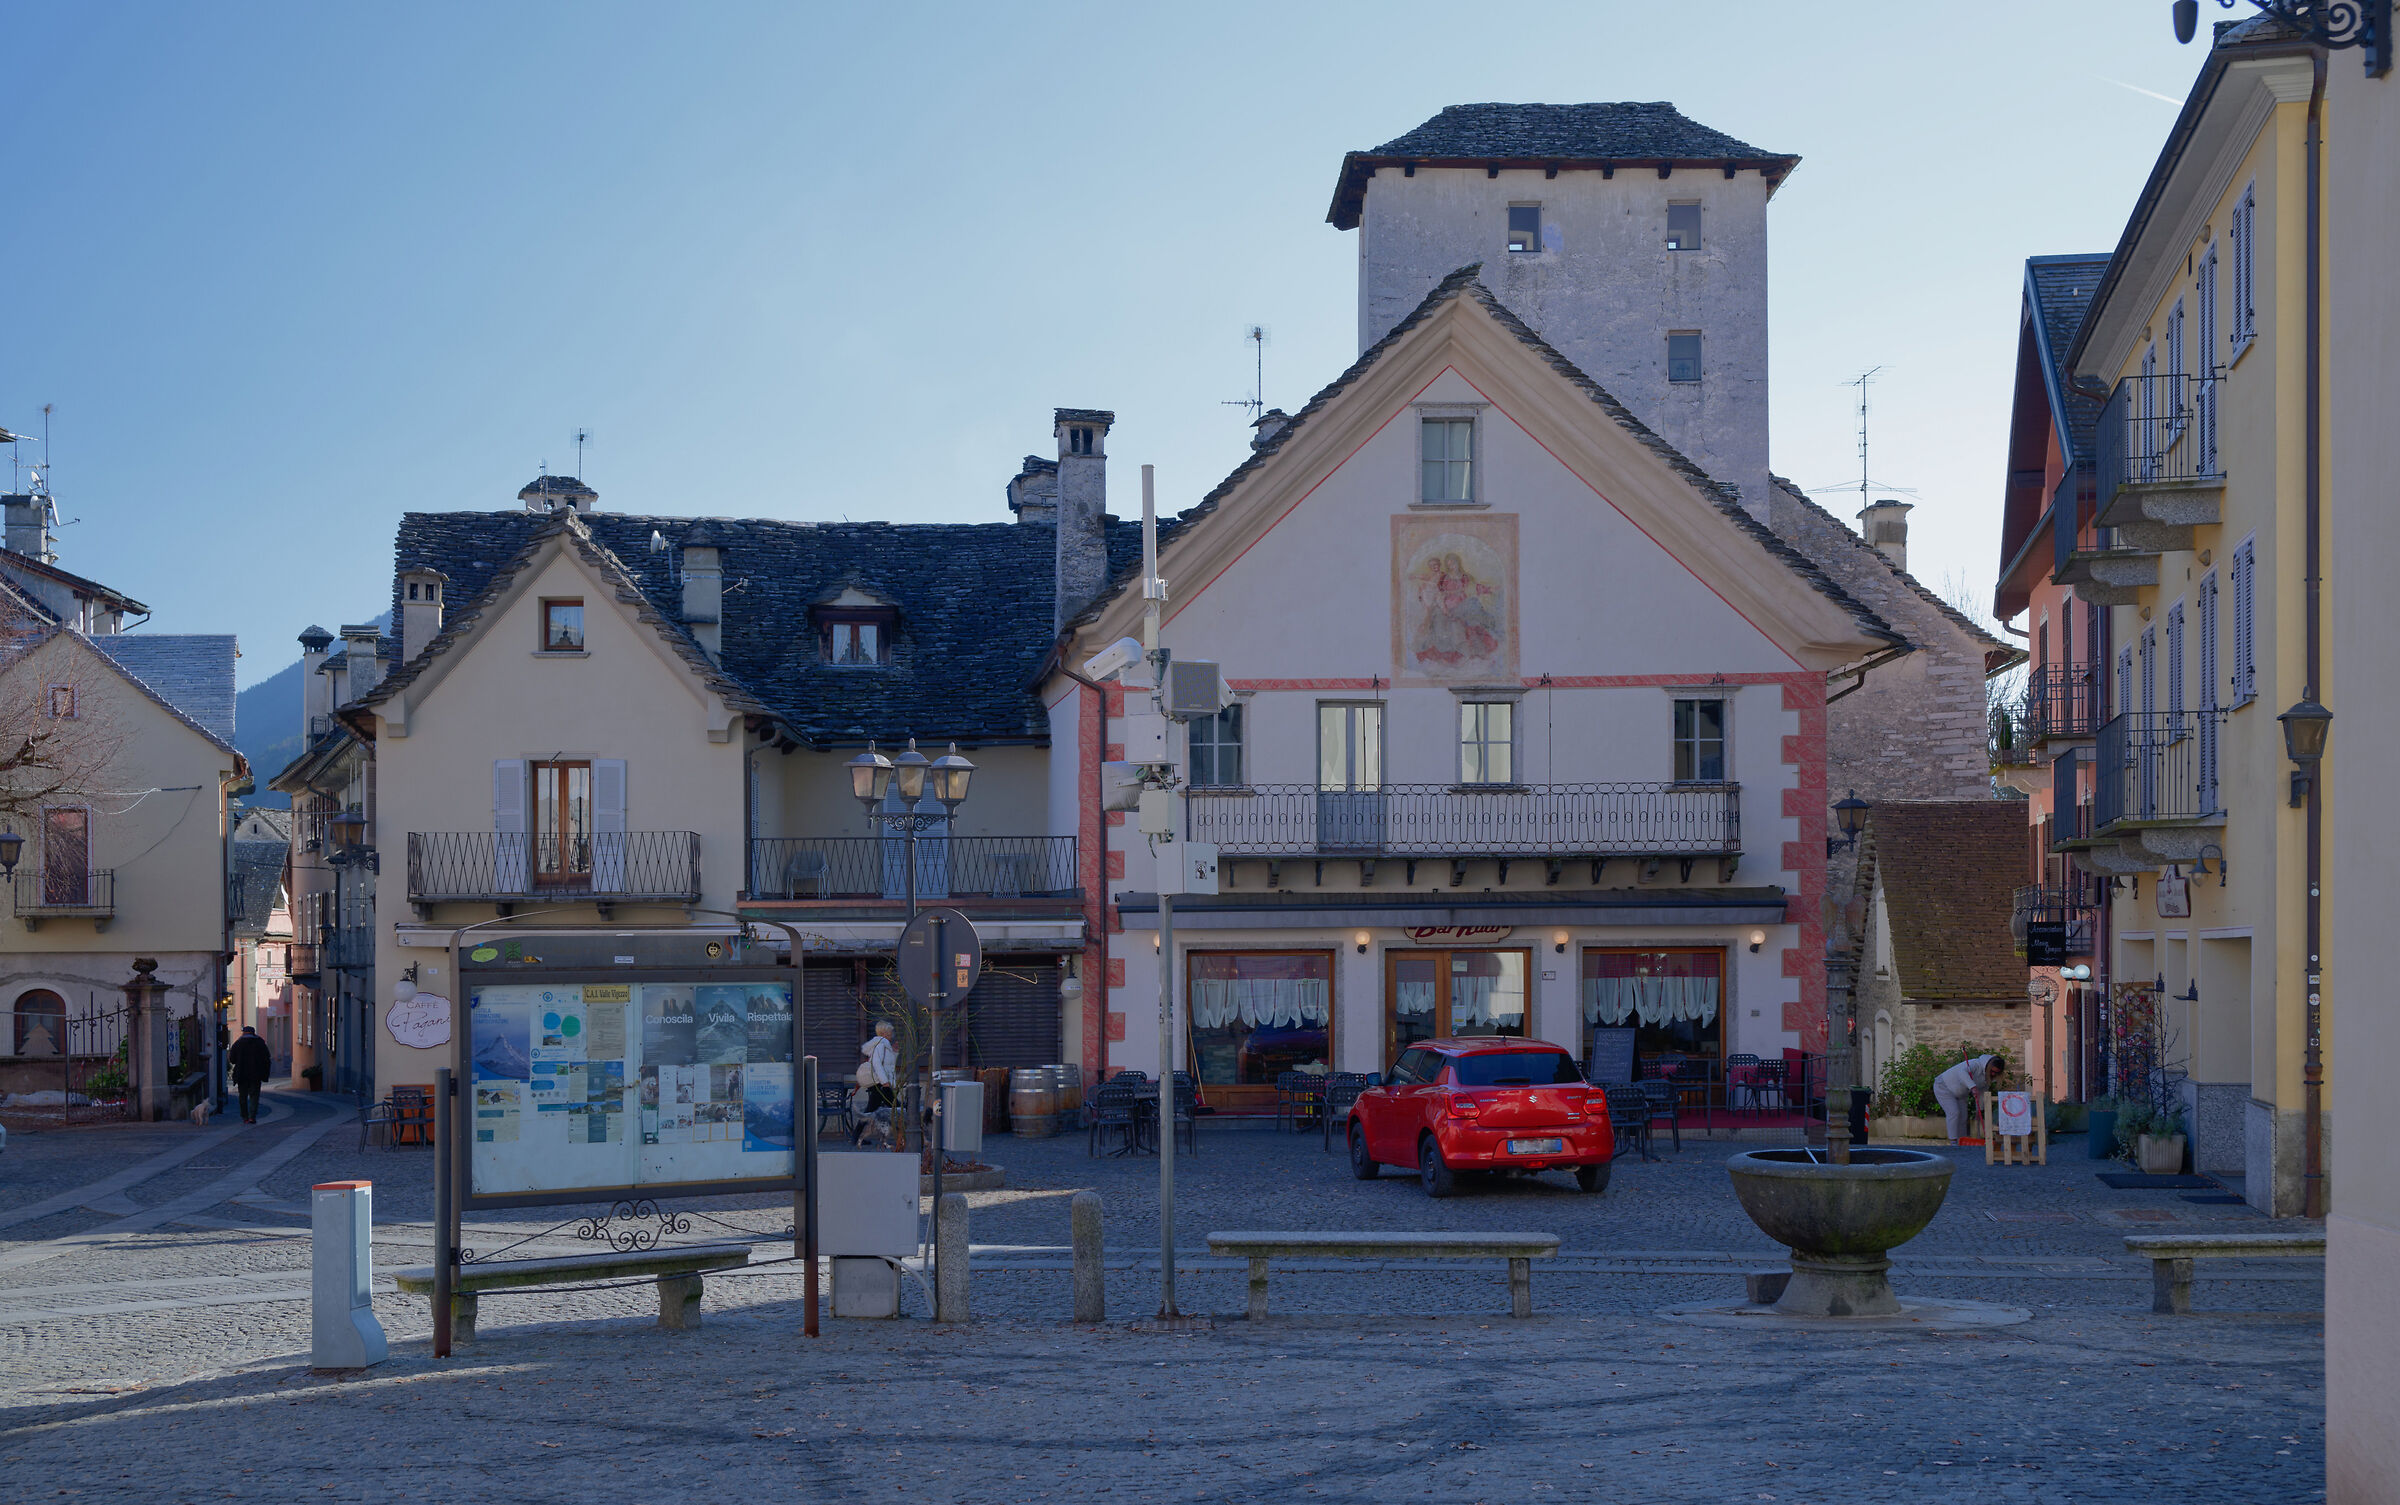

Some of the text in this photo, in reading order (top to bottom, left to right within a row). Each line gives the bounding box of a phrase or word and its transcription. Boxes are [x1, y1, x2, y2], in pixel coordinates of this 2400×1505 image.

[407, 1000, 439, 1009] CAFFÈ
[645, 1013, 693, 1024] Conoscila
[708, 1012, 735, 1023] Vivila
[391, 1012, 450, 1037] Pagan
